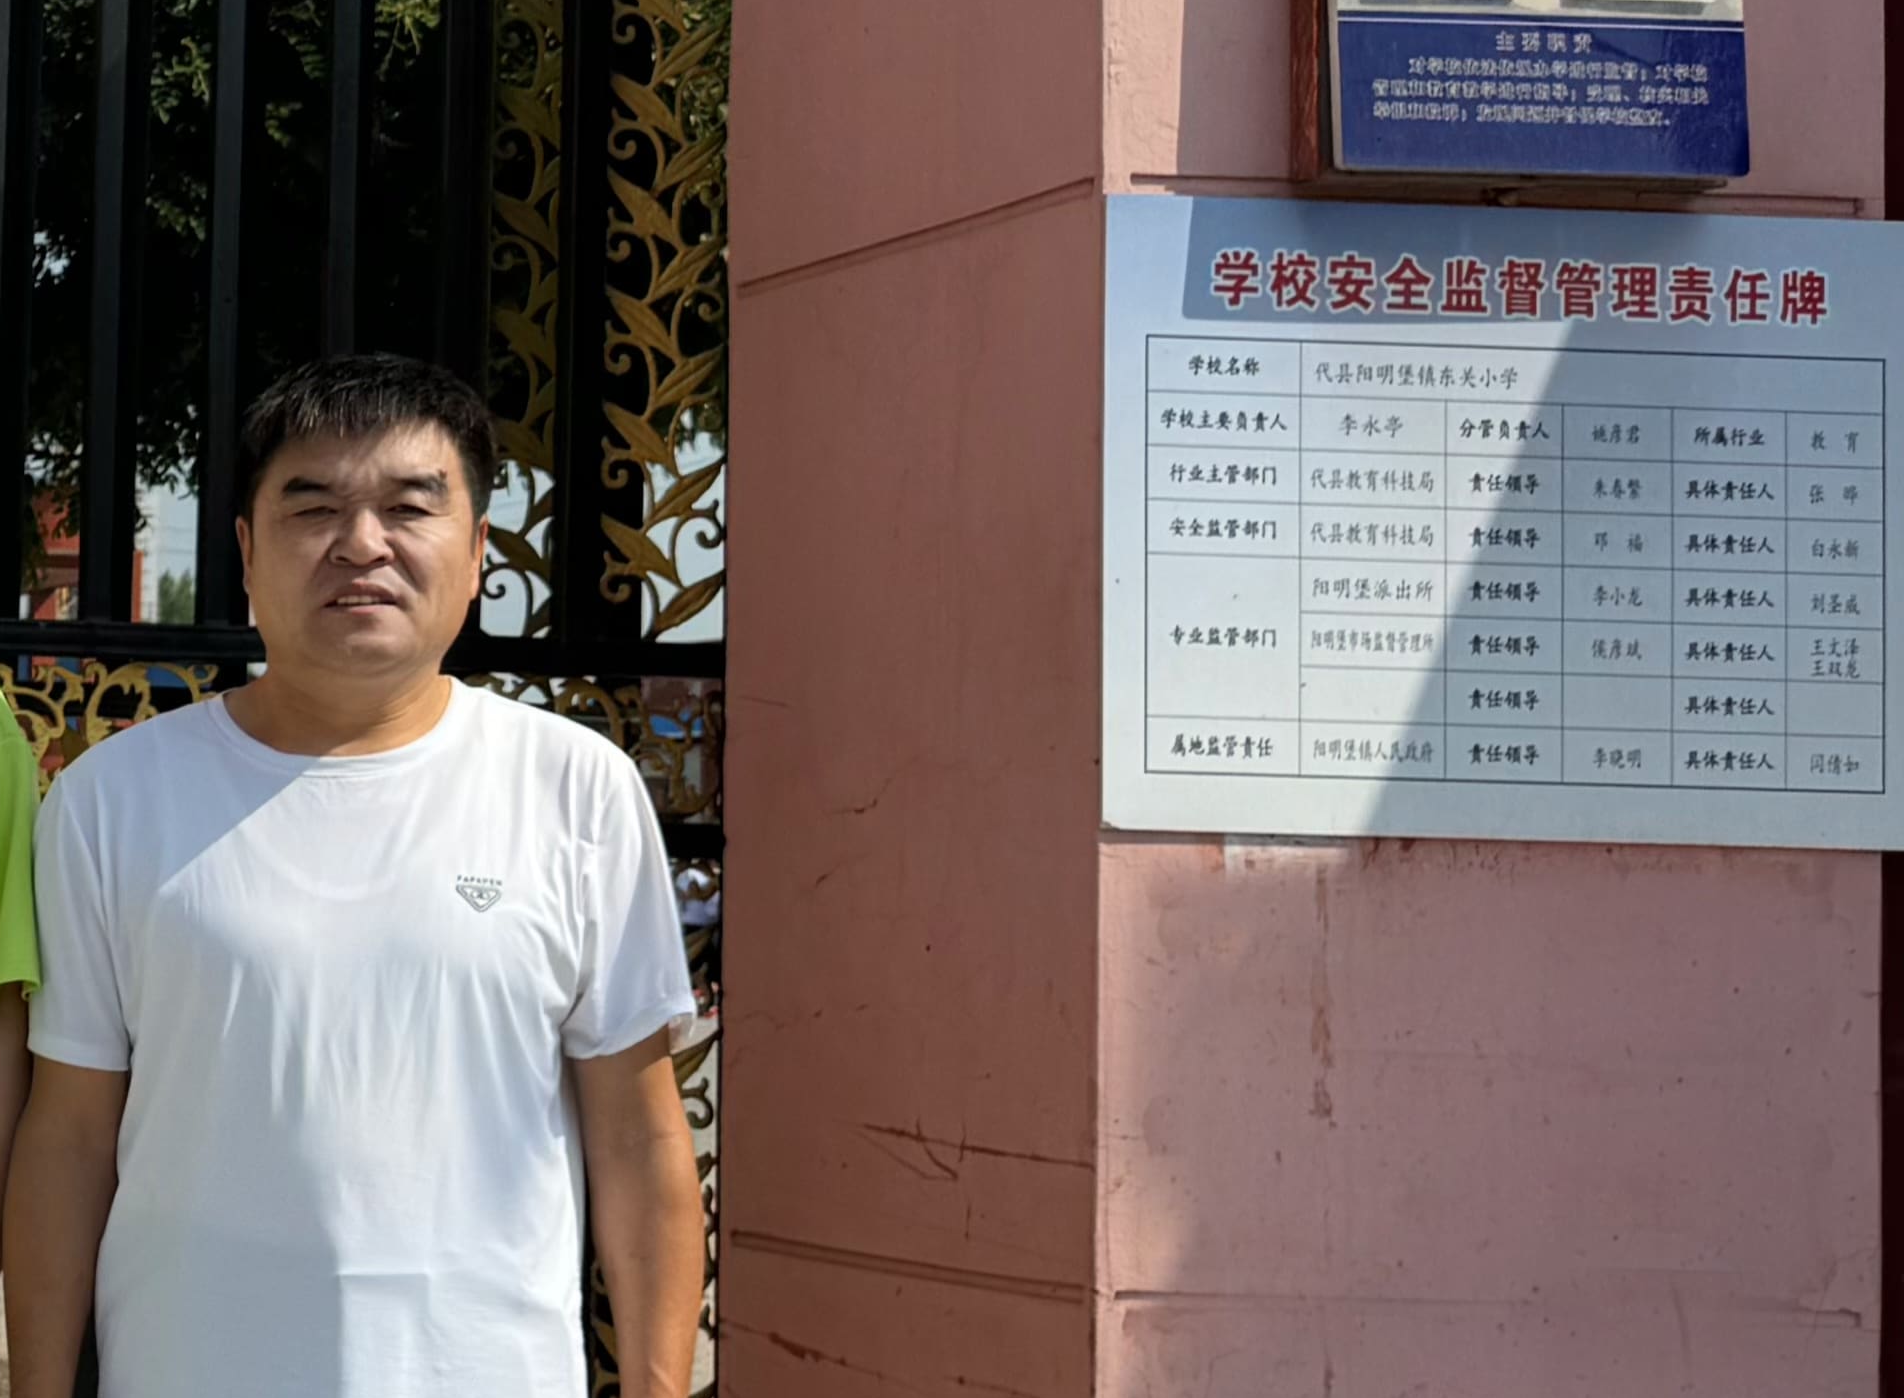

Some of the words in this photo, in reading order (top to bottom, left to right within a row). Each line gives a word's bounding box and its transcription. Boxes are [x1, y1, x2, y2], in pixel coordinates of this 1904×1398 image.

[1212, 250, 1829, 326] 学校安全监督管理责任牌
[1189, 355, 1260, 376] 学校名称
[1161, 408, 1287, 432] 学校主要负责人
[1460, 419, 1549, 439] 分管负责人
[1694, 427, 1765, 446] 所属行业
[1169, 463, 1277, 485] 行业主管部门
[1311, 469, 1434, 492] 代县教育科技局
[1469, 473, 1540, 494] 责任领导
[1685, 481, 1774, 501] 具体责任人
[1169, 517, 1277, 540] 安全监管部门
[1311, 523, 1434, 546] 代县教育科技局
[1469, 528, 1540, 549] 责任领导
[1685, 534, 1774, 554] 具体责任人
[1313, 578, 1433, 601] 阳明堡派出所
[1469, 581, 1540, 602] 责任领导
[1685, 588, 1774, 609] 具体责任人
[1169, 625, 1277, 648] 专业监管部门
[1469, 635, 1540, 656] 责任领导
[1685, 642, 1774, 663] 具体责任人
[1469, 688, 1540, 710] 责任领导
[1685, 696, 1774, 716] 具体责任人
[1171, 734, 1273, 758] 属地监管责任
[1469, 743, 1540, 765] 责任领导
[1684, 750, 1774, 770] 具体责任人
